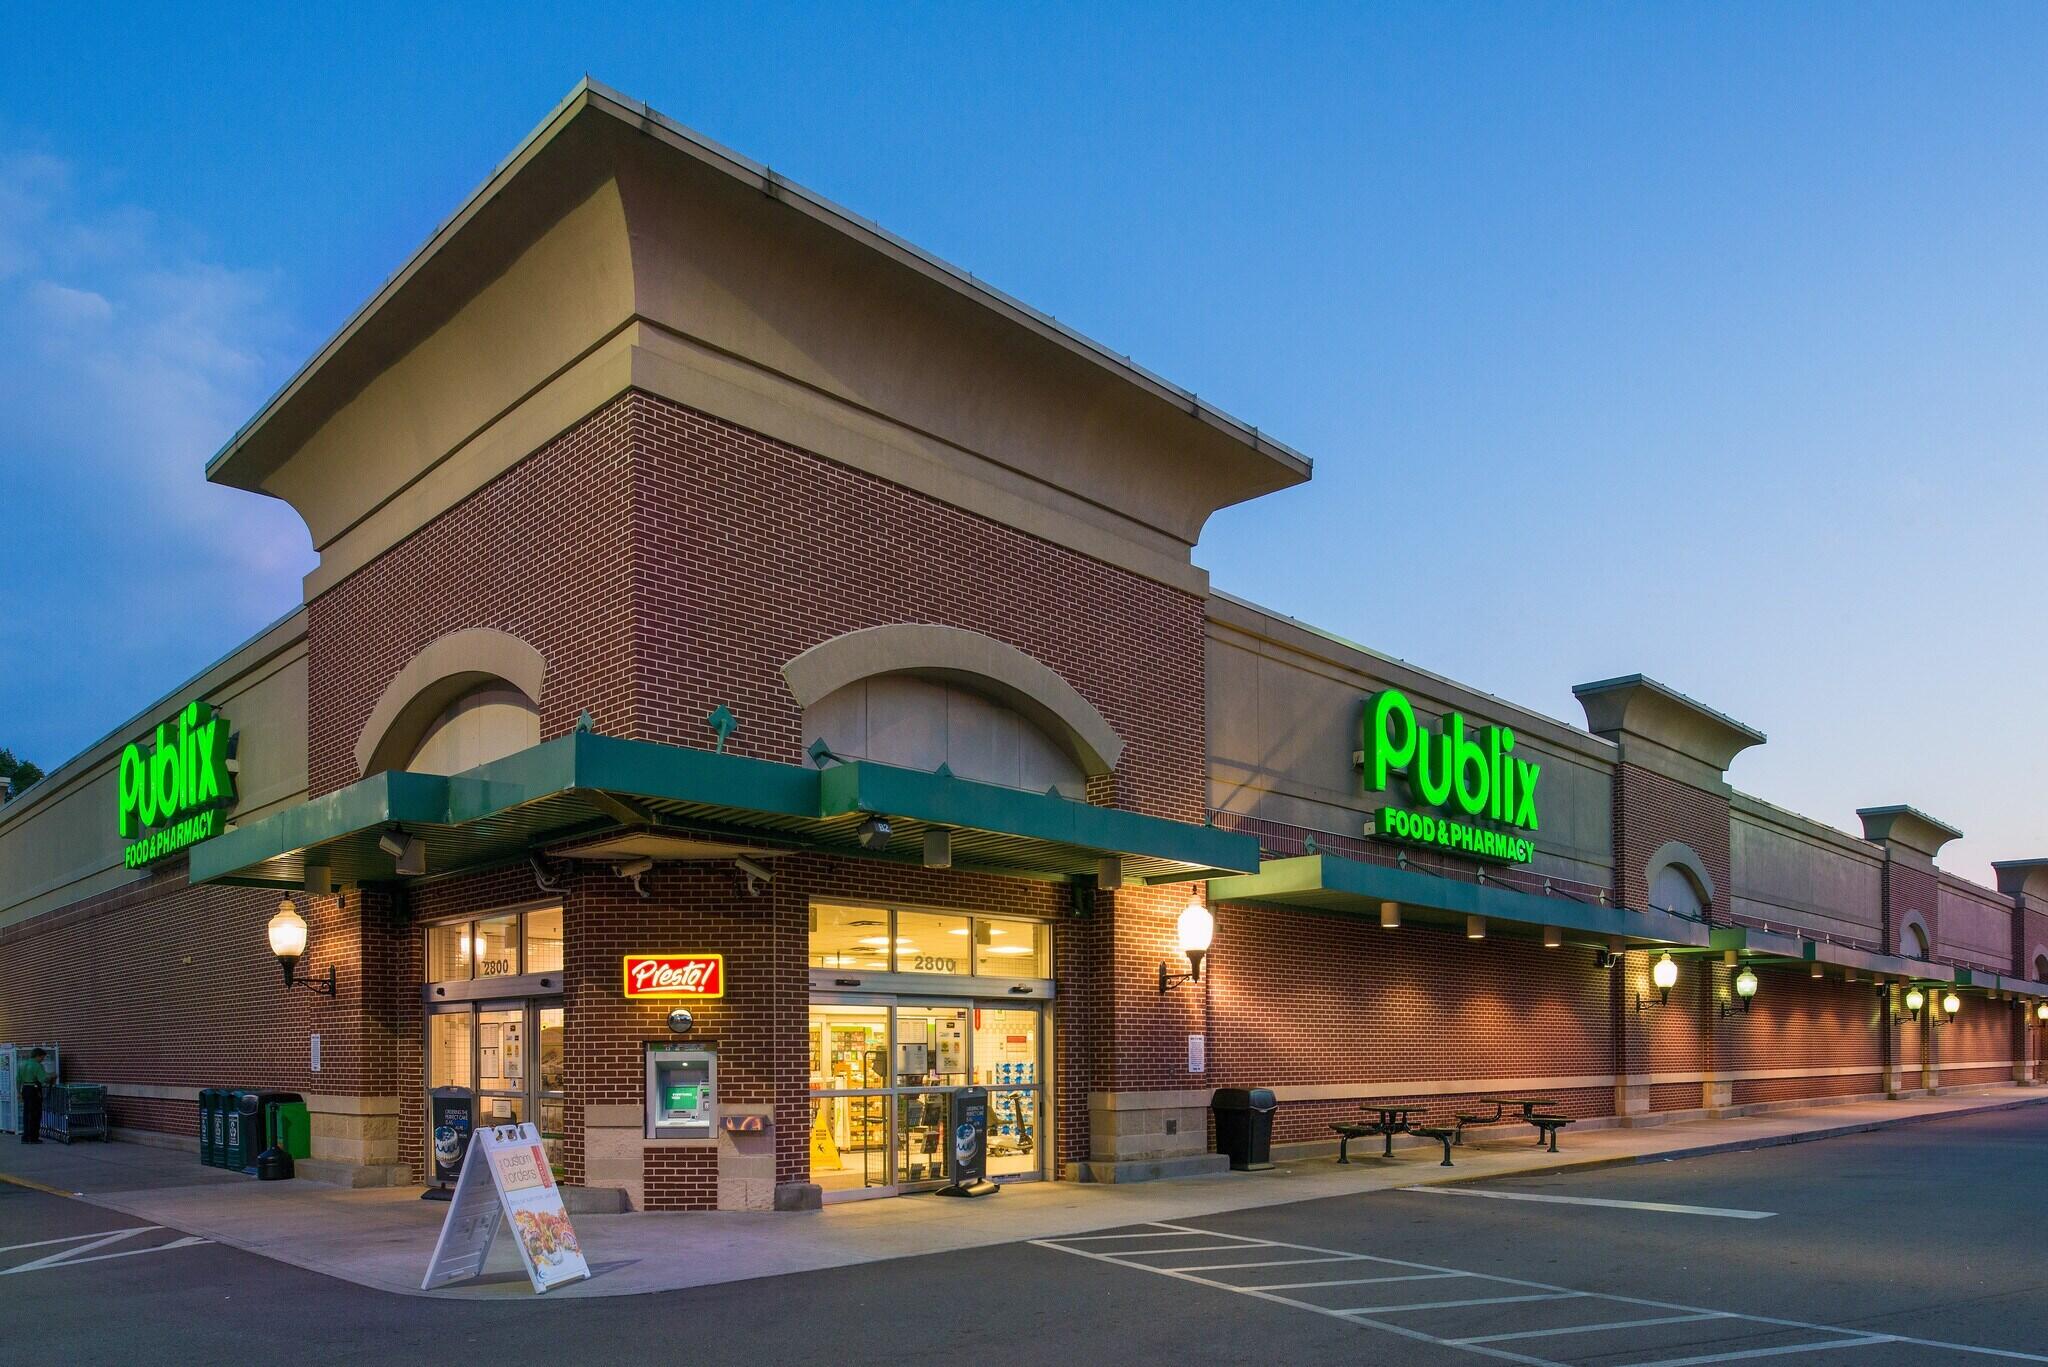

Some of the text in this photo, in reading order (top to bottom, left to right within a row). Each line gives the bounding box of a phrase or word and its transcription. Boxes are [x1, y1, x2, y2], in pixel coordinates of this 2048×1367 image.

[119, 701, 222, 837] Publix
[1370, 689, 1541, 831] Publix
[125, 839, 149, 869] FOOD
[156, 808, 214, 853] PHARMACY
[1384, 807, 1436, 842] FOOD
[1450, 824, 1535, 864] PHARMACY
[483, 959, 509, 976] 2800
[631, 960, 714, 993] Presto!
[914, 955, 955, 972] 2800
[508, 1168, 537, 1184] orders
